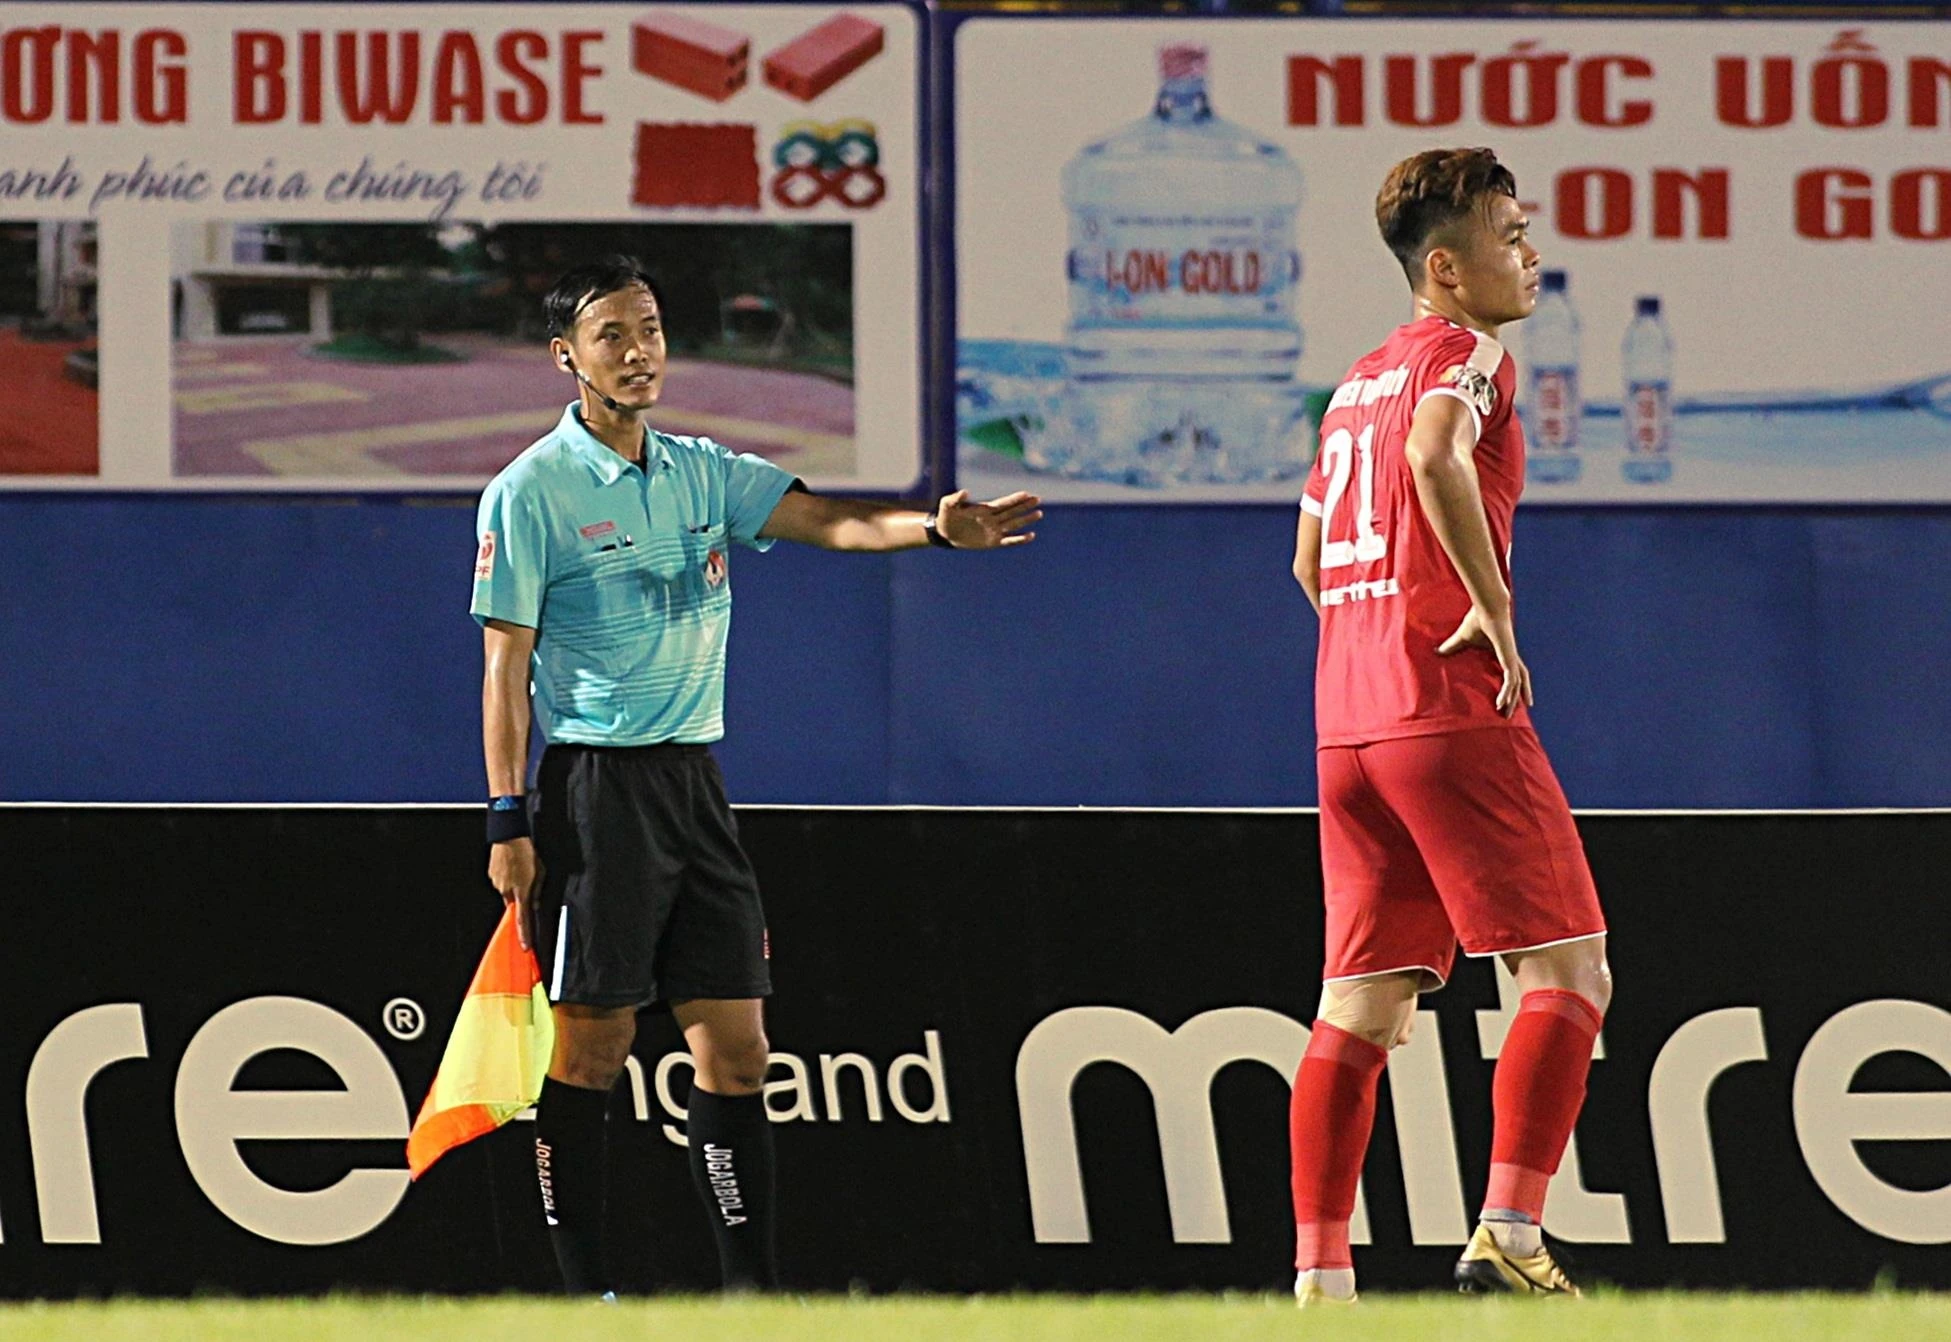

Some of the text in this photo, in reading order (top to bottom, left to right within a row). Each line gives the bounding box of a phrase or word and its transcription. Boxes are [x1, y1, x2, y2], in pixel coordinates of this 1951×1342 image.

[231, 26, 606, 126] BIWASE
[1285, 39, 1655, 128] NƯỚC
[1179, 249, 1260, 295] GOLD
[1320, 423, 1387, 570] 21
[0, 993, 413, 1246] re
[703, 1142, 748, 1227] JOGARBOLA
